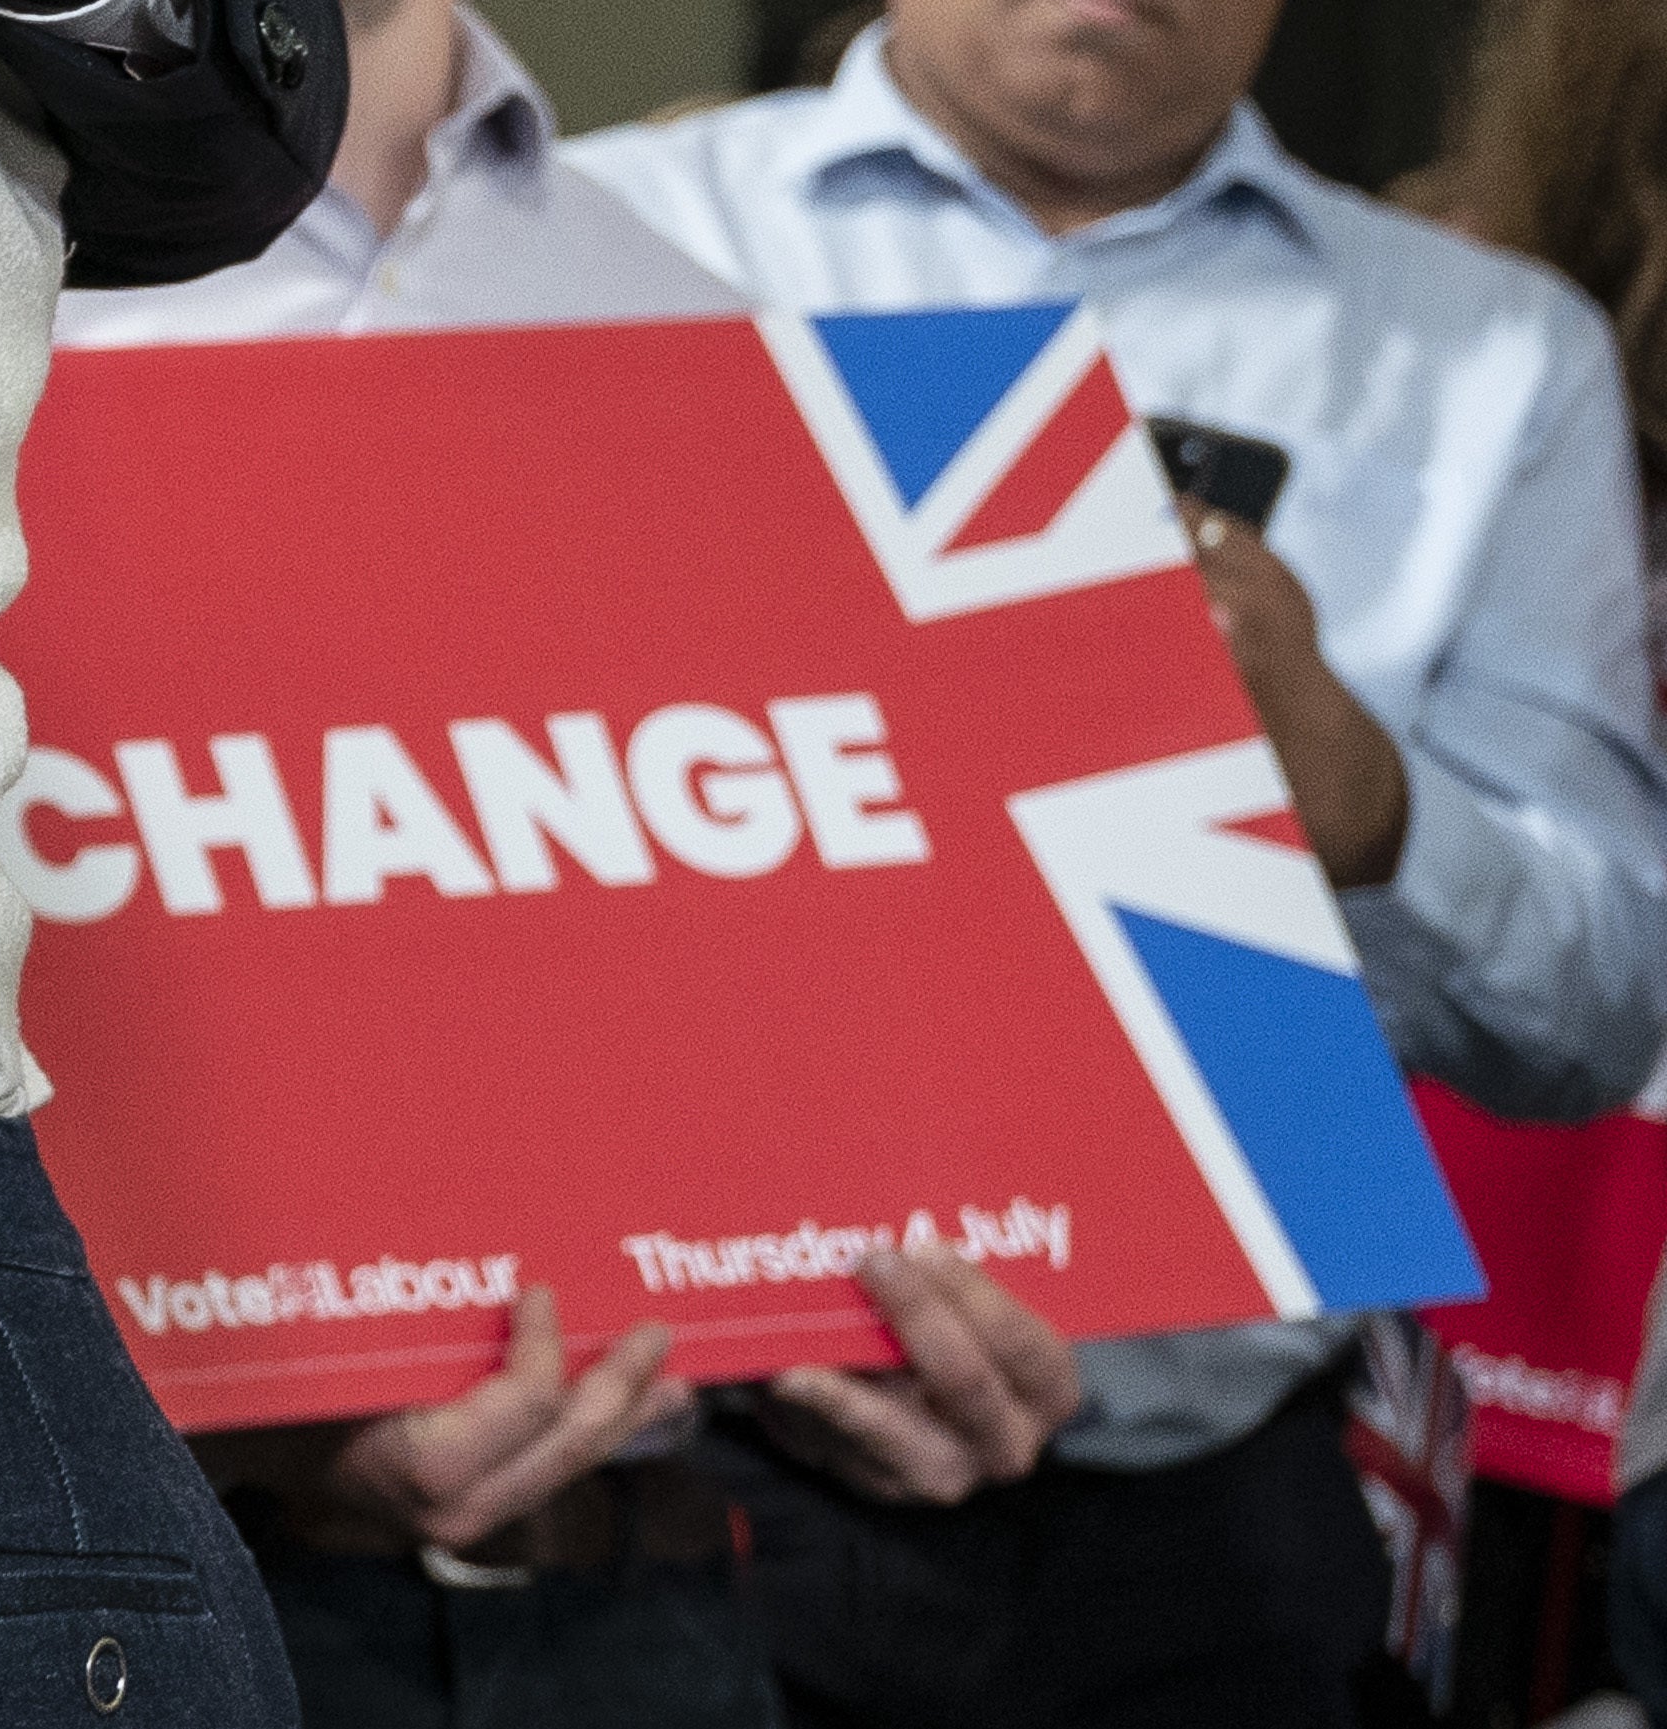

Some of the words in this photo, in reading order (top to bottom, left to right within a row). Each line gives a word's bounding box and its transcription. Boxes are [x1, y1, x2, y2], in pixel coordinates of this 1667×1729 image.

[953, 1195, 1072, 1271] July
[116, 1269, 274, 1335] Vote
[310, 1254, 519, 1320] Labour
